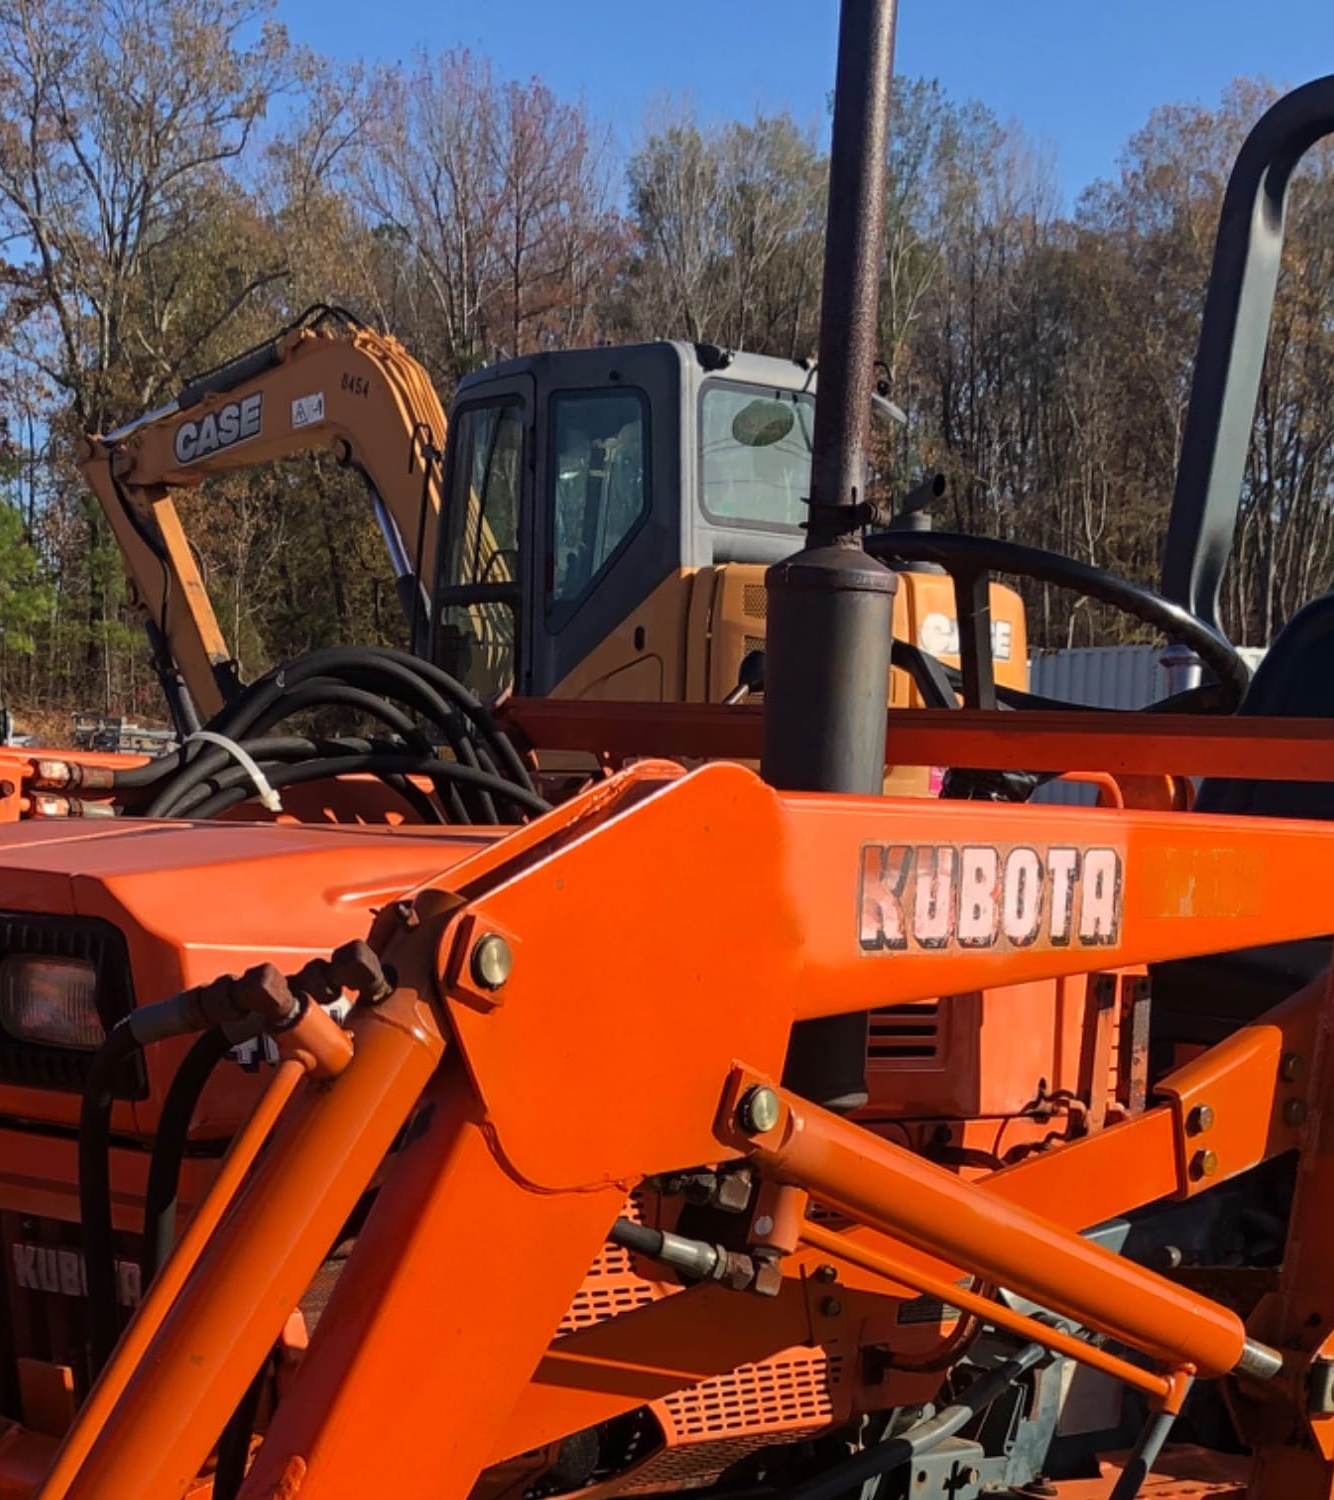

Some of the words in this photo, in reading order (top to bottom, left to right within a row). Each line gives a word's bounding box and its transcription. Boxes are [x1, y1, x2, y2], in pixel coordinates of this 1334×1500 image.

[174, 391, 262, 464] CASE
[859, 845, 1121, 949] KUBOTA
[13, 1243, 142, 1307] KUBA
